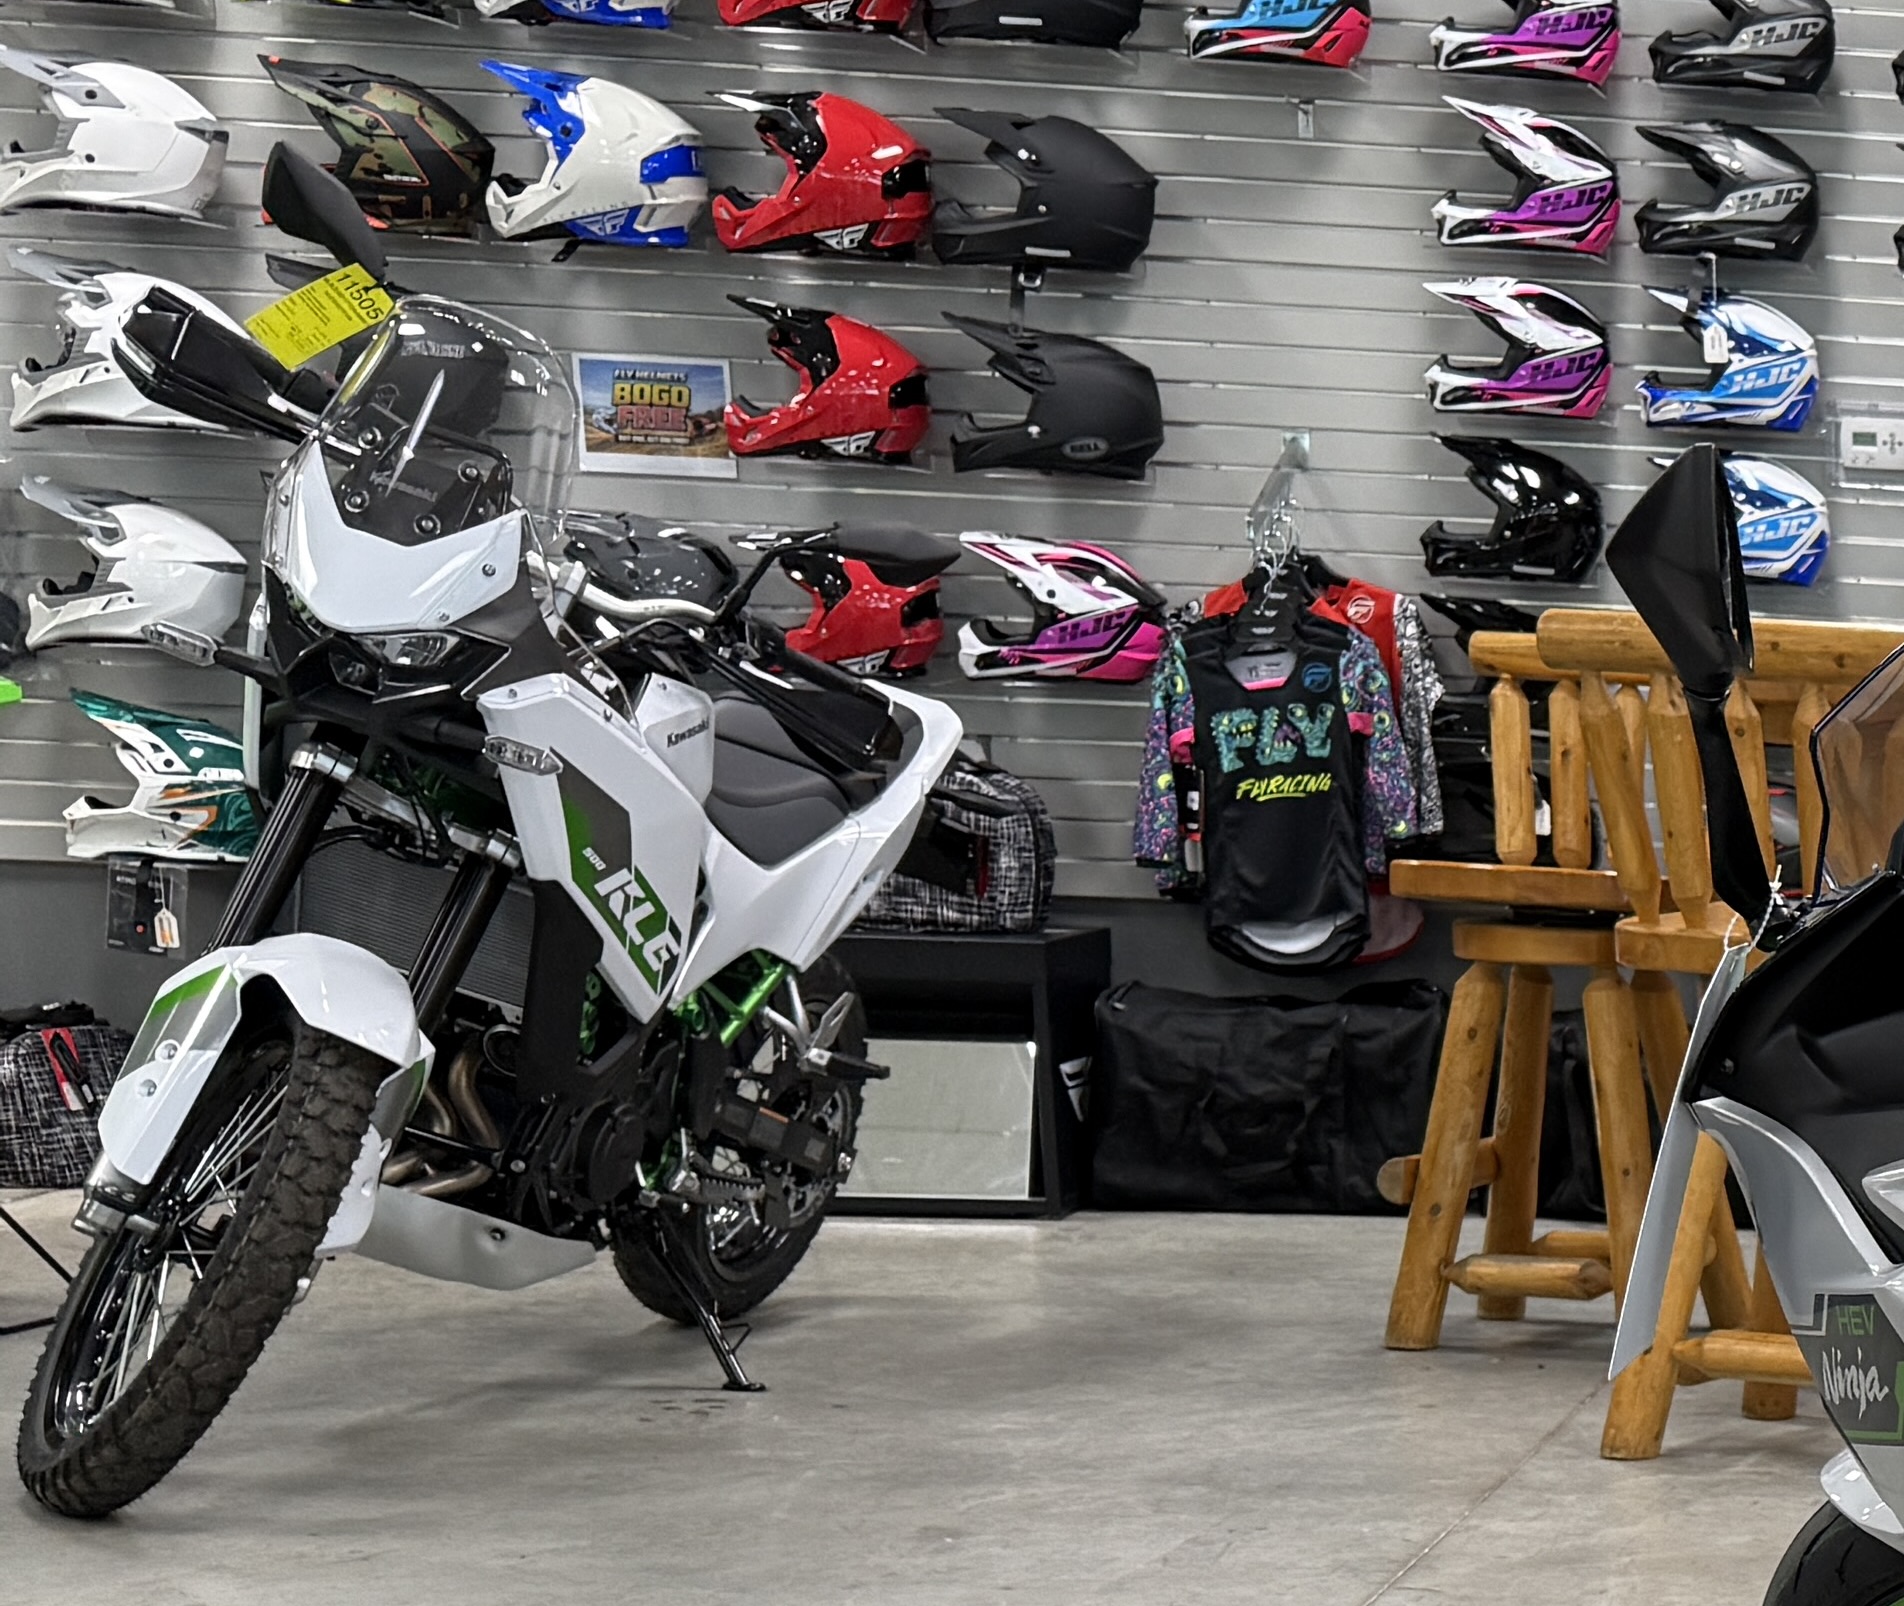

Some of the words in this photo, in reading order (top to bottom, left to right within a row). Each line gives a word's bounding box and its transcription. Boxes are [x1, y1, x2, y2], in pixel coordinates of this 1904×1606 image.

[1537, 9, 1609, 36] HJC
[1752, 21, 1822, 46] HJC
[1539, 184, 1610, 216] HJC
[1737, 187, 1805, 214] HJC
[340, 272, 386, 322] 11505
[1529, 352, 1601, 384] HJC
[1732, 359, 1804, 390] HJC
[613, 382, 692, 408] BOGO
[1740, 516, 1814, 545] HJC
[1057, 608, 1127, 643] HJC
[667, 715, 711, 748] Kawasaki
[1210, 702, 1337, 773] FLY
[1836, 1305, 1874, 1335] HEV
[1821, 1346, 1889, 1421] Ninja
